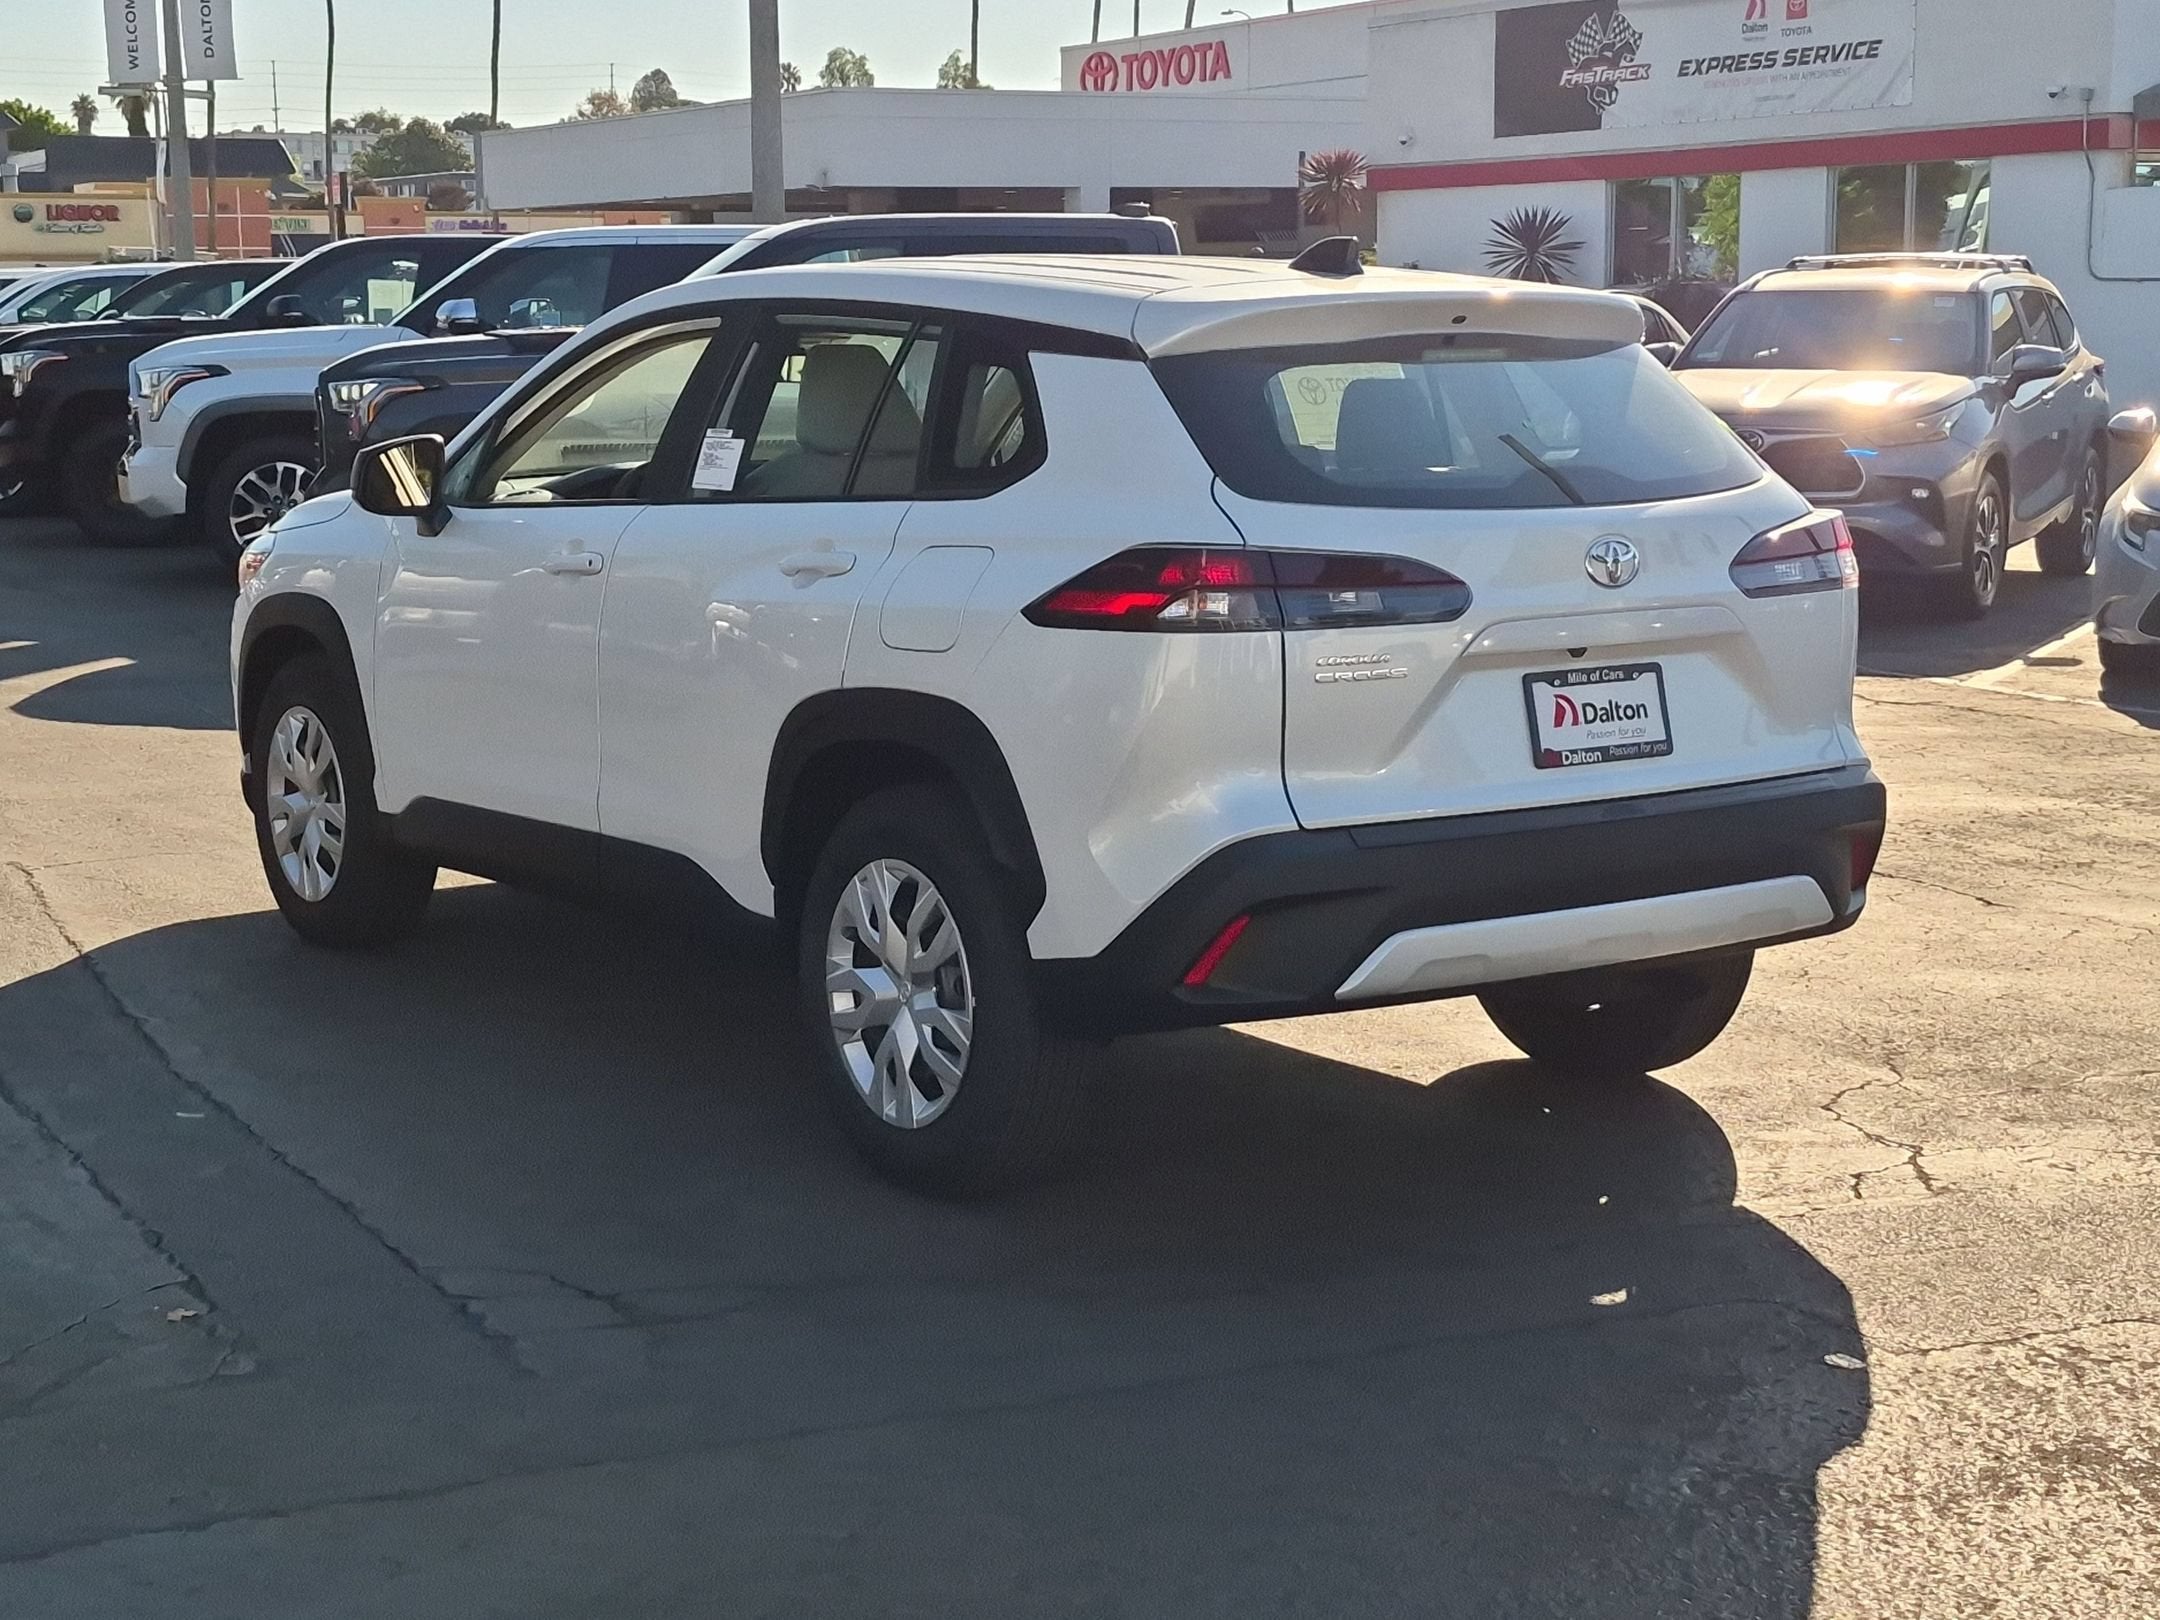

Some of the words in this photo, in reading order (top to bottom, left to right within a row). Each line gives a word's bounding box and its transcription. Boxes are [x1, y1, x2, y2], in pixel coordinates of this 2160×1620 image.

[1741, 23, 1768, 34] Dalton
[1781, 26, 1812, 37] TOYOTA
[1121, 40, 1232, 91] TOYOTA
[1677, 50, 1779, 77] EXPRESS
[1781, 39, 1883, 67] SERVICE
[46, 204, 120, 221] LIQUOR
[1316, 653, 1390, 666] COROLLA
[1315, 668, 1408, 683] CROSS
[1568, 672, 1588, 684] Mile
[1590, 671, 1600, 681] of
[1602, 669, 1624, 680] Cars
[1582, 699, 1648, 724] Dalton
[1586, 728, 1616, 740] Passion
[1619, 726, 1631, 736] for
[1631, 726, 1647, 738] you
[1562, 751, 1602, 765] Dalton
[1609, 745, 1639, 757] Passion
[1640, 743, 1652, 754] for
[1652, 742, 1668, 753] you
